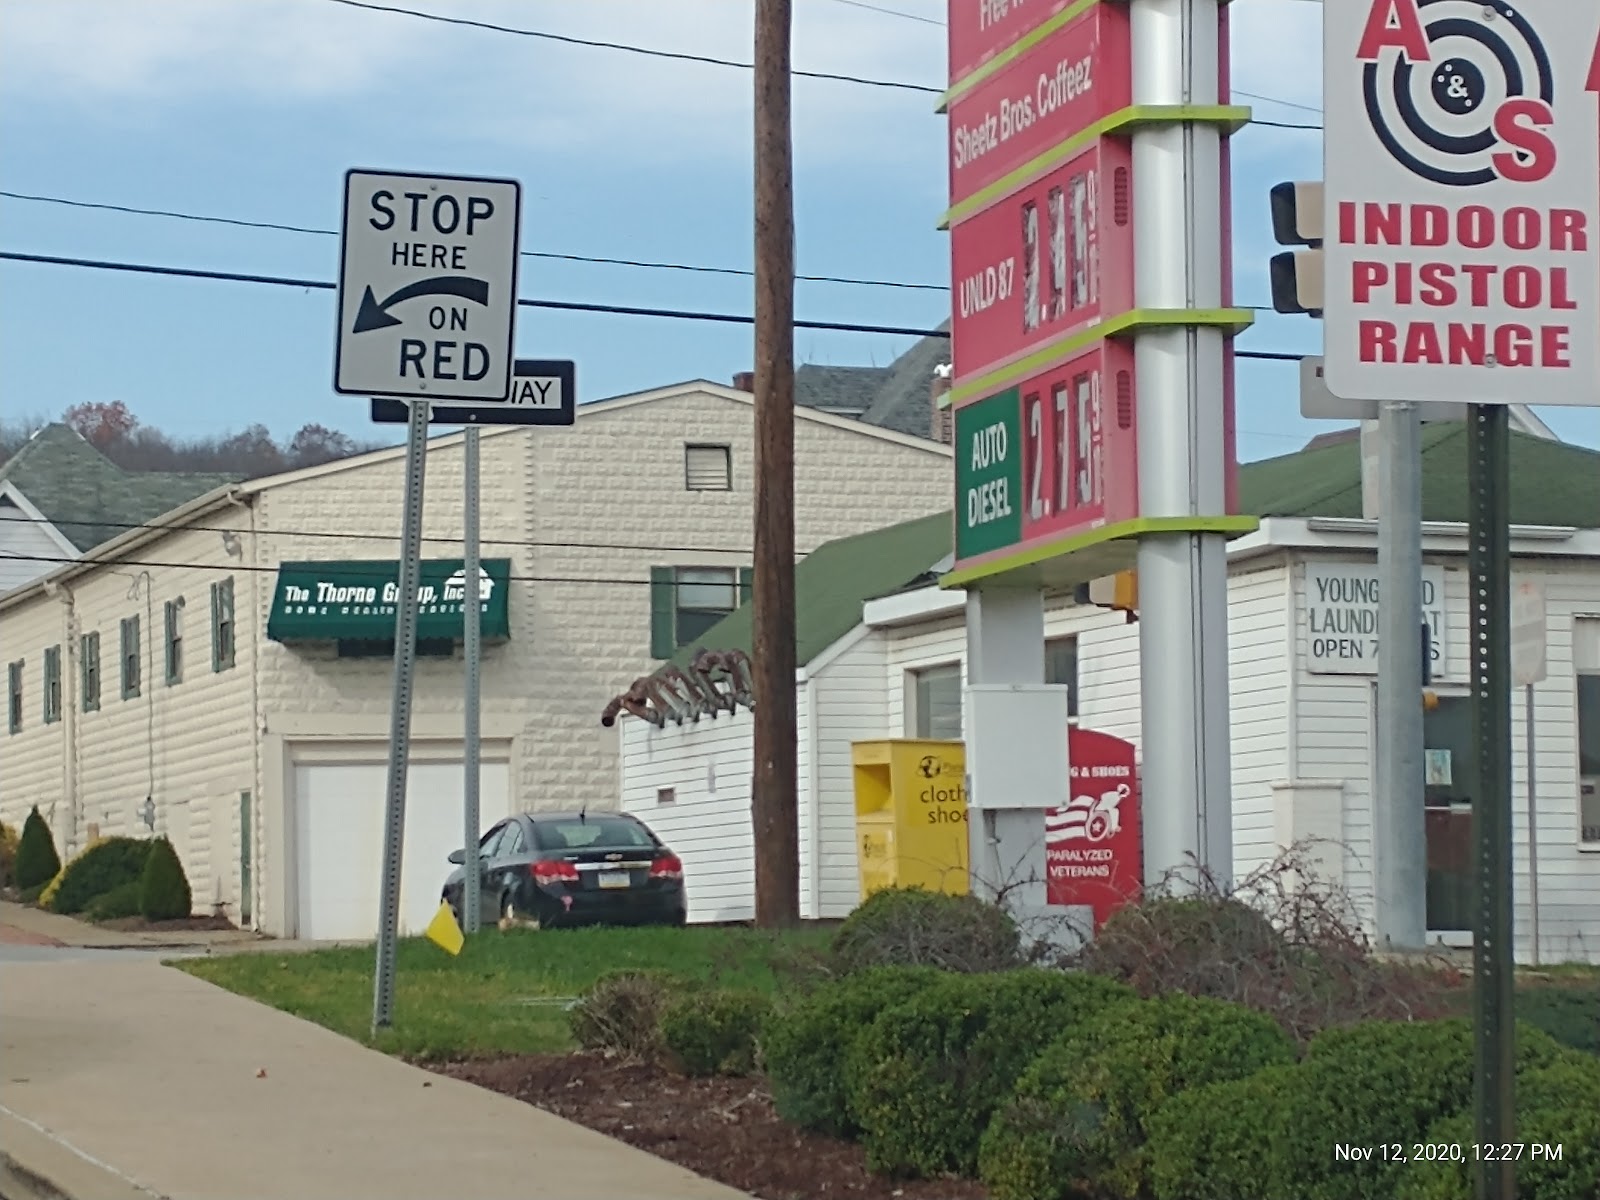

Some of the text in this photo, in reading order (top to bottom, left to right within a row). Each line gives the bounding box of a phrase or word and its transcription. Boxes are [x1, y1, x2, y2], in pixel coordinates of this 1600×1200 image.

[955, 56, 1092, 168] Sheetz Bros. Coffeez
[1356, 0, 1557, 182] A & S
[369, 190, 495, 236] STOP
[1338, 201, 1588, 252] INDOOR
[391, 242, 467, 269] HERE
[960, 257, 1016, 319] UNLD 87
[1352, 261, 1578, 310] PISTOL
[429, 306, 468, 331] ON
[399, 338, 490, 381] RED
[1359, 320, 1571, 368] RANGE
[511, 380, 552, 404] AY
[972, 421, 1007, 472] AUTO
[967, 477, 1012, 528] DIESEL
[285, 586, 309, 602] The
[317, 582, 376, 603] Thorne
[1313, 639, 1363, 659] OPEN
[1091, 765, 1130, 778] SHOES
[1046, 848, 1113, 861] PARALYZED
[1049, 864, 1110, 878] VETERANS
